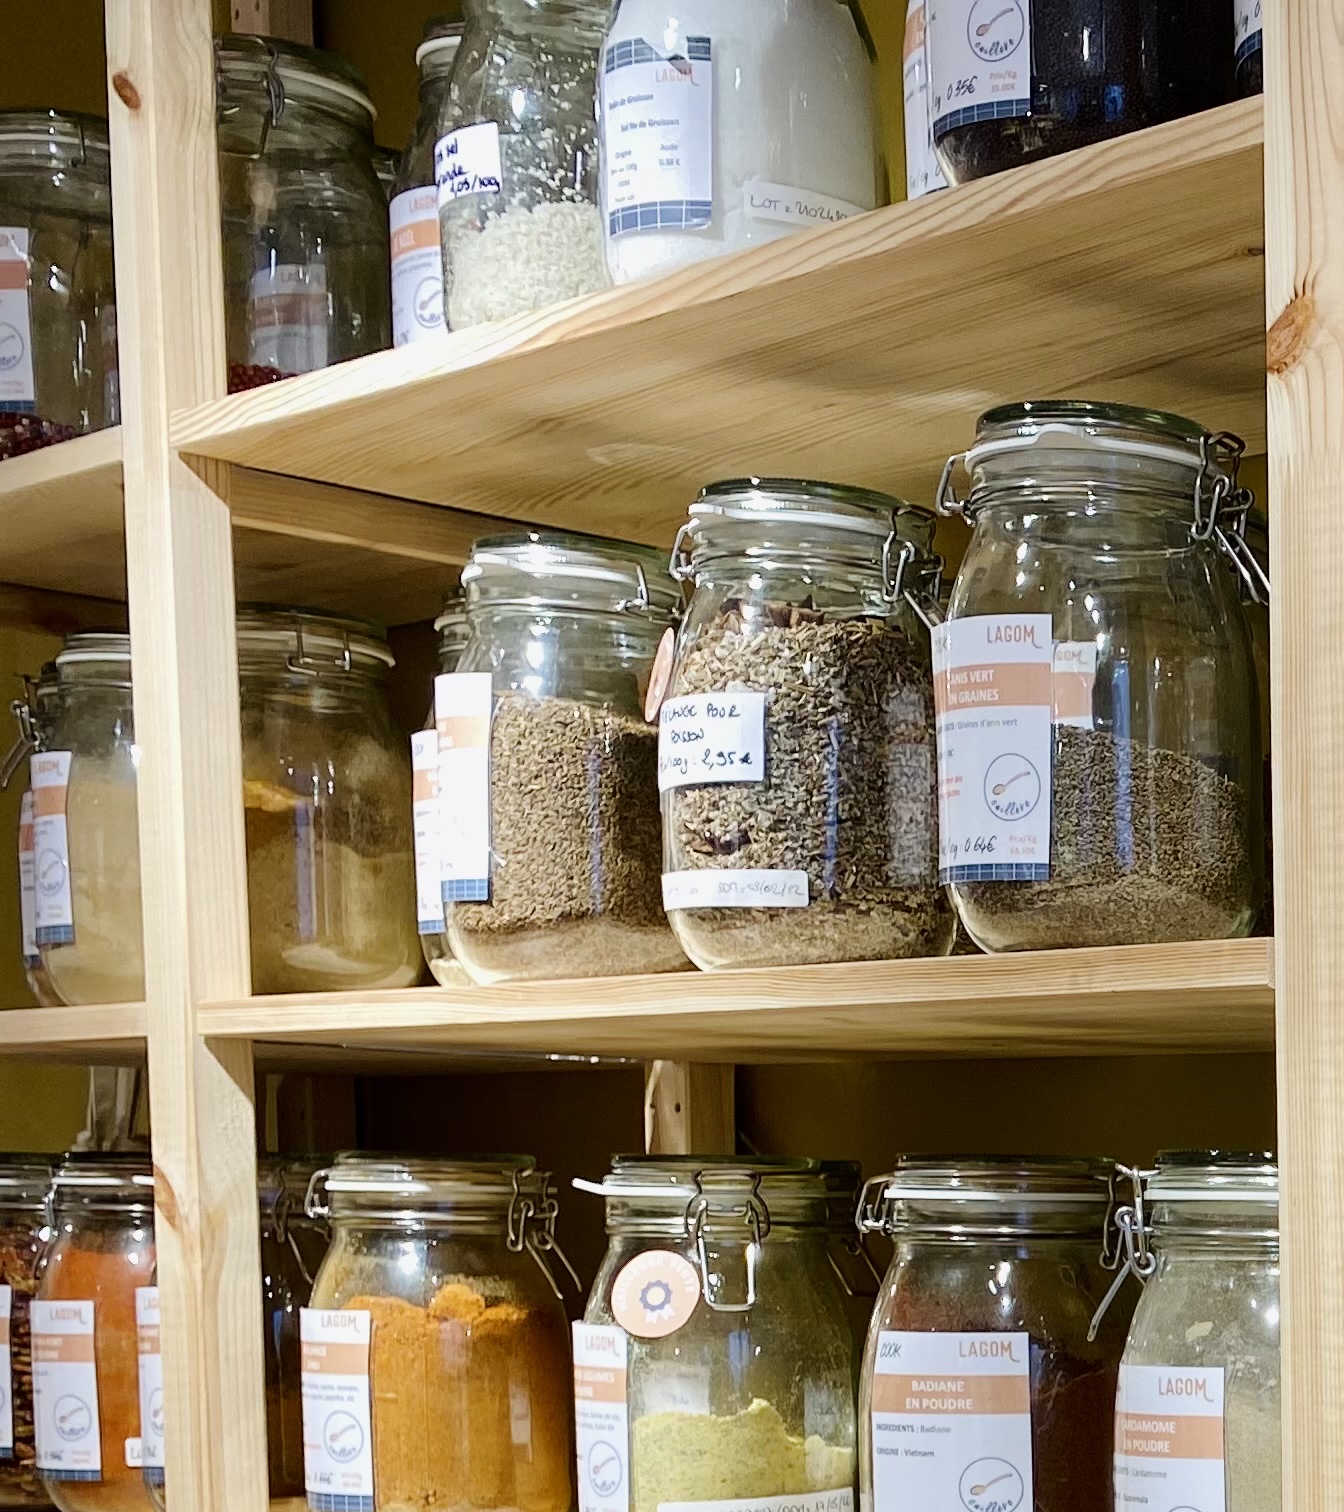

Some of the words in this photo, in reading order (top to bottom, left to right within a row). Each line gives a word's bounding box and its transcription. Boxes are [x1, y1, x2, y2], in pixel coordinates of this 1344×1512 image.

[987, 625, 1042, 649] LAGOM
[970, 670, 994, 682] VERT
[959, 689, 999, 703] GRAINES
[706, 703, 741, 717] POUR
[959, 1340, 1020, 1363] LAGOM
[911, 1380, 965, 1392] BADIANE
[1158, 1376, 1214, 1403] LAGOM
[906, 1397, 920, 1409] EN
[922, 1397, 973, 1410] POUDRE
[904, 1449, 934, 1457] Vietnam
[1133, 1439, 1171, 1453] POUDRE
